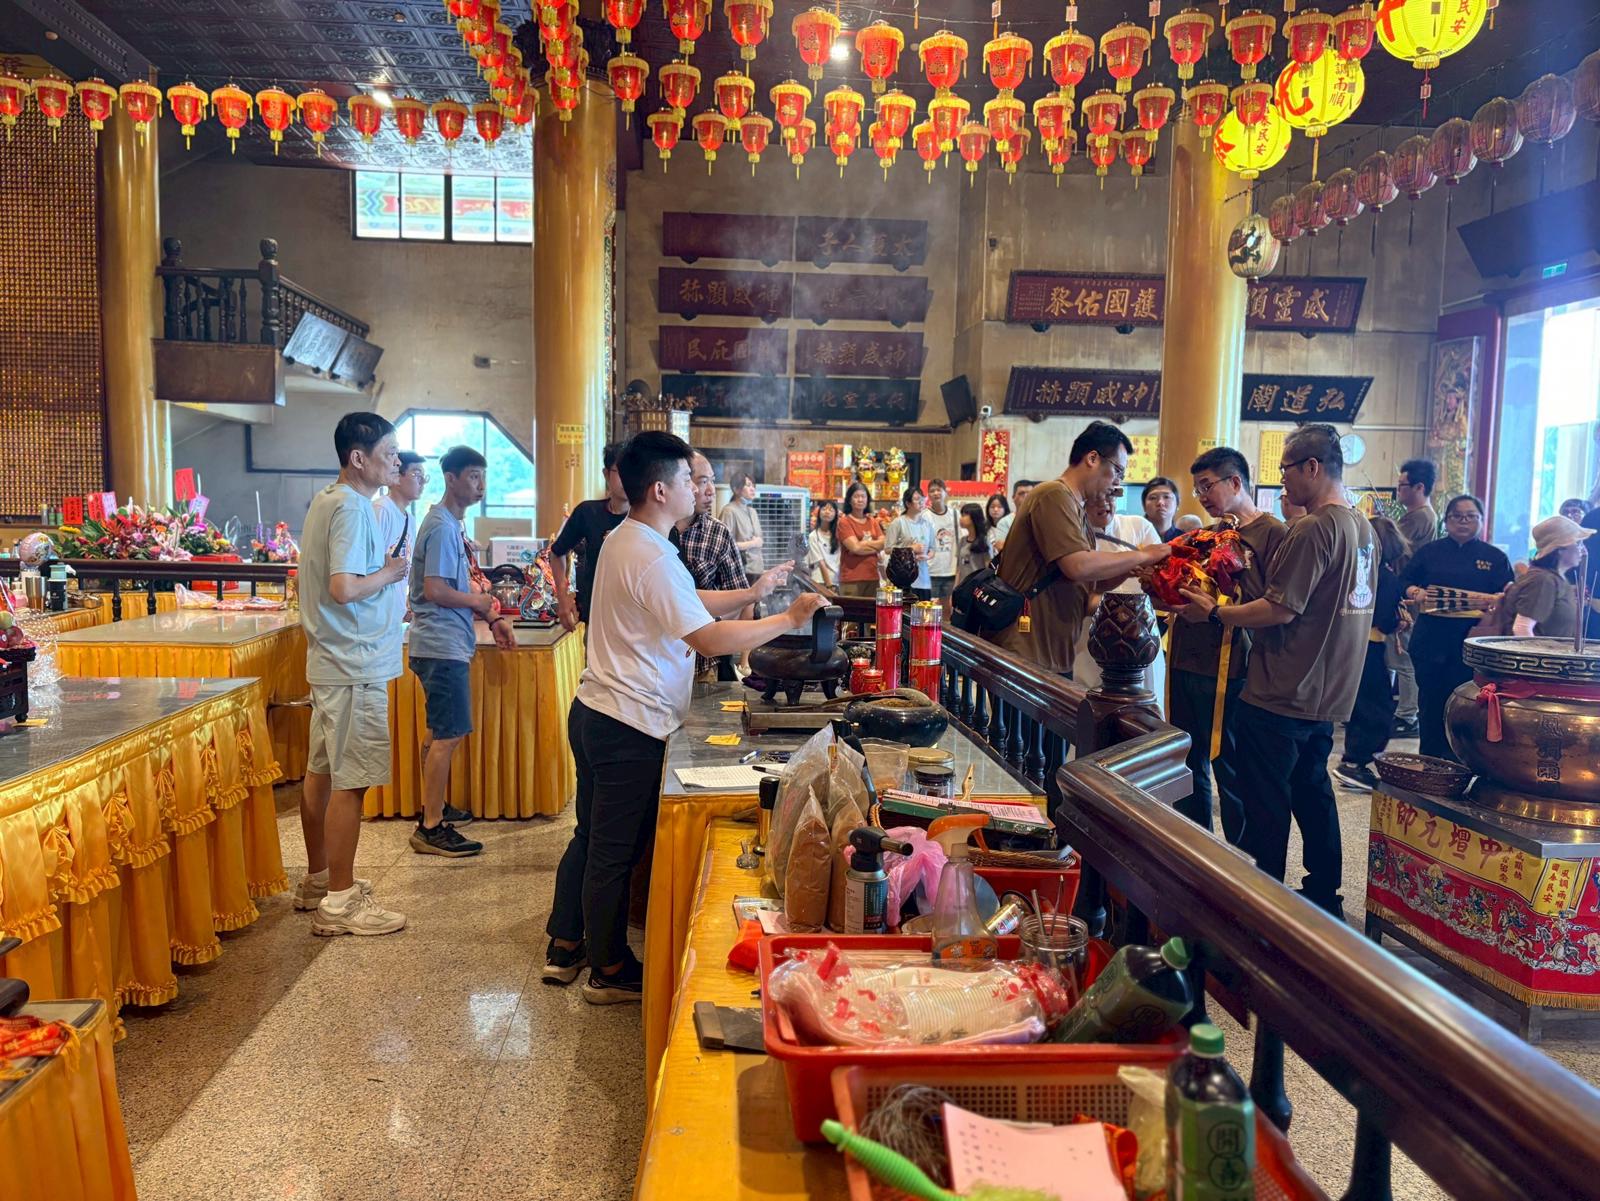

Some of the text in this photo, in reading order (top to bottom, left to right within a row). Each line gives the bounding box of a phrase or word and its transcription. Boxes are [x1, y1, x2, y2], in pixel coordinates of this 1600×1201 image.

[1254, 103, 1271, 156] 泰民安
[1537, 714, 1564, 783] 風調雨
